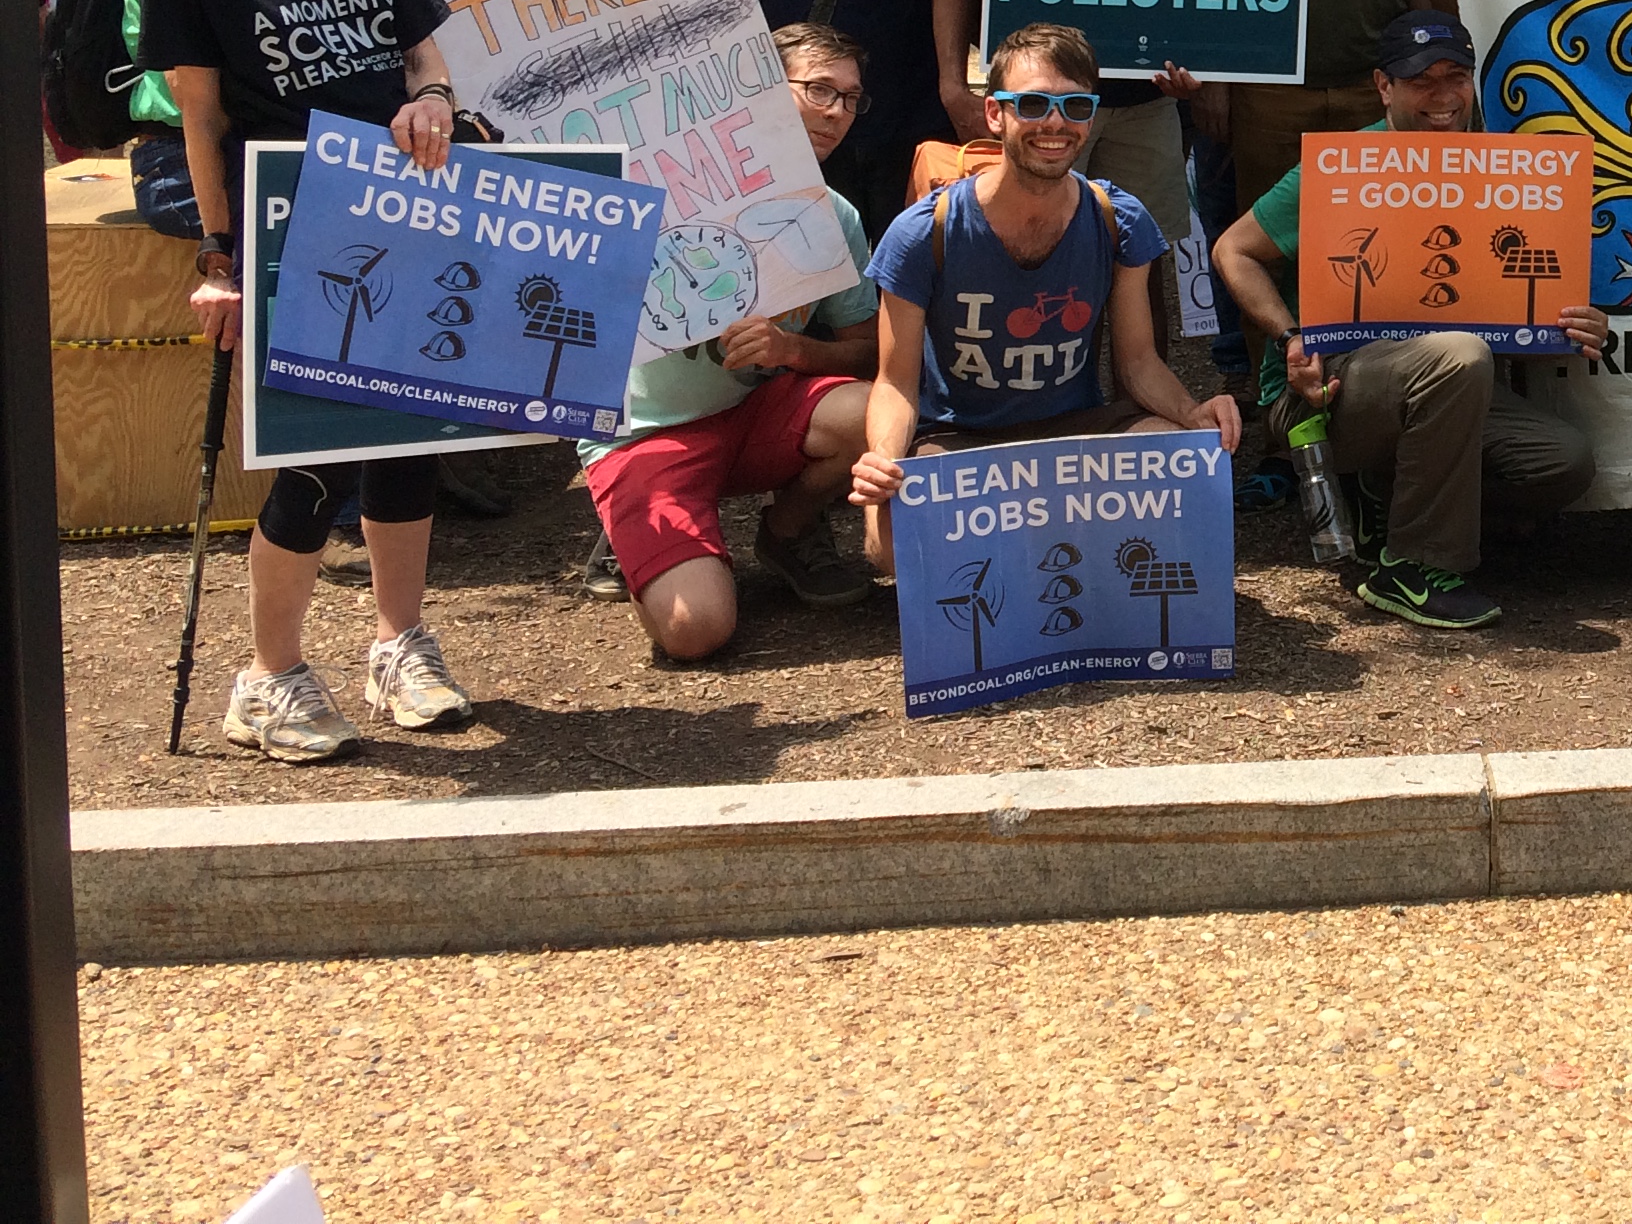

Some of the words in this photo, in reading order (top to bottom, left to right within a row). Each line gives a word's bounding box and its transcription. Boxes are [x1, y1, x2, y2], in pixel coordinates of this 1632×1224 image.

[254, 11, 276, 35] A
[259, 10, 398, 72] SCIENC
[660, 31, 784, 137] MUCH
[316, 131, 463, 194] CLEAN
[473, 169, 657, 231] ENERGY
[628, 107, 776, 228] IME
[1317, 147, 1430, 174] CLEAN
[1441, 148, 1581, 176] ENERGY
[1359, 182, 1465, 208] GOOD
[1474, 184, 1564, 211] JOBS
[349, 185, 462, 237] JOBS
[475, 212, 602, 265] NOW!
[713, 229, 726, 248] 2
[733, 244, 747, 260] 3
[742, 266, 752, 281] 4
[651, 314, 669, 331] 8
[708, 308, 719, 326] 6
[734, 289, 747, 312] 5
[954, 292, 995, 339] I
[677, 319, 691, 341] 7
[269, 358, 519, 415] BEYONDCOAL.ORG/CLEAN-ENERGY
[949, 338, 1089, 391] ATL
[898, 458, 1038, 507] CLEAN
[1055, 446, 1222, 485] ENERGY
[945, 497, 1050, 542] JOBS
[1065, 488, 1182, 524] NOW!
[909, 656, 1141, 707] BEYONDCOAL.ORG/CLEAN-ENERGY
